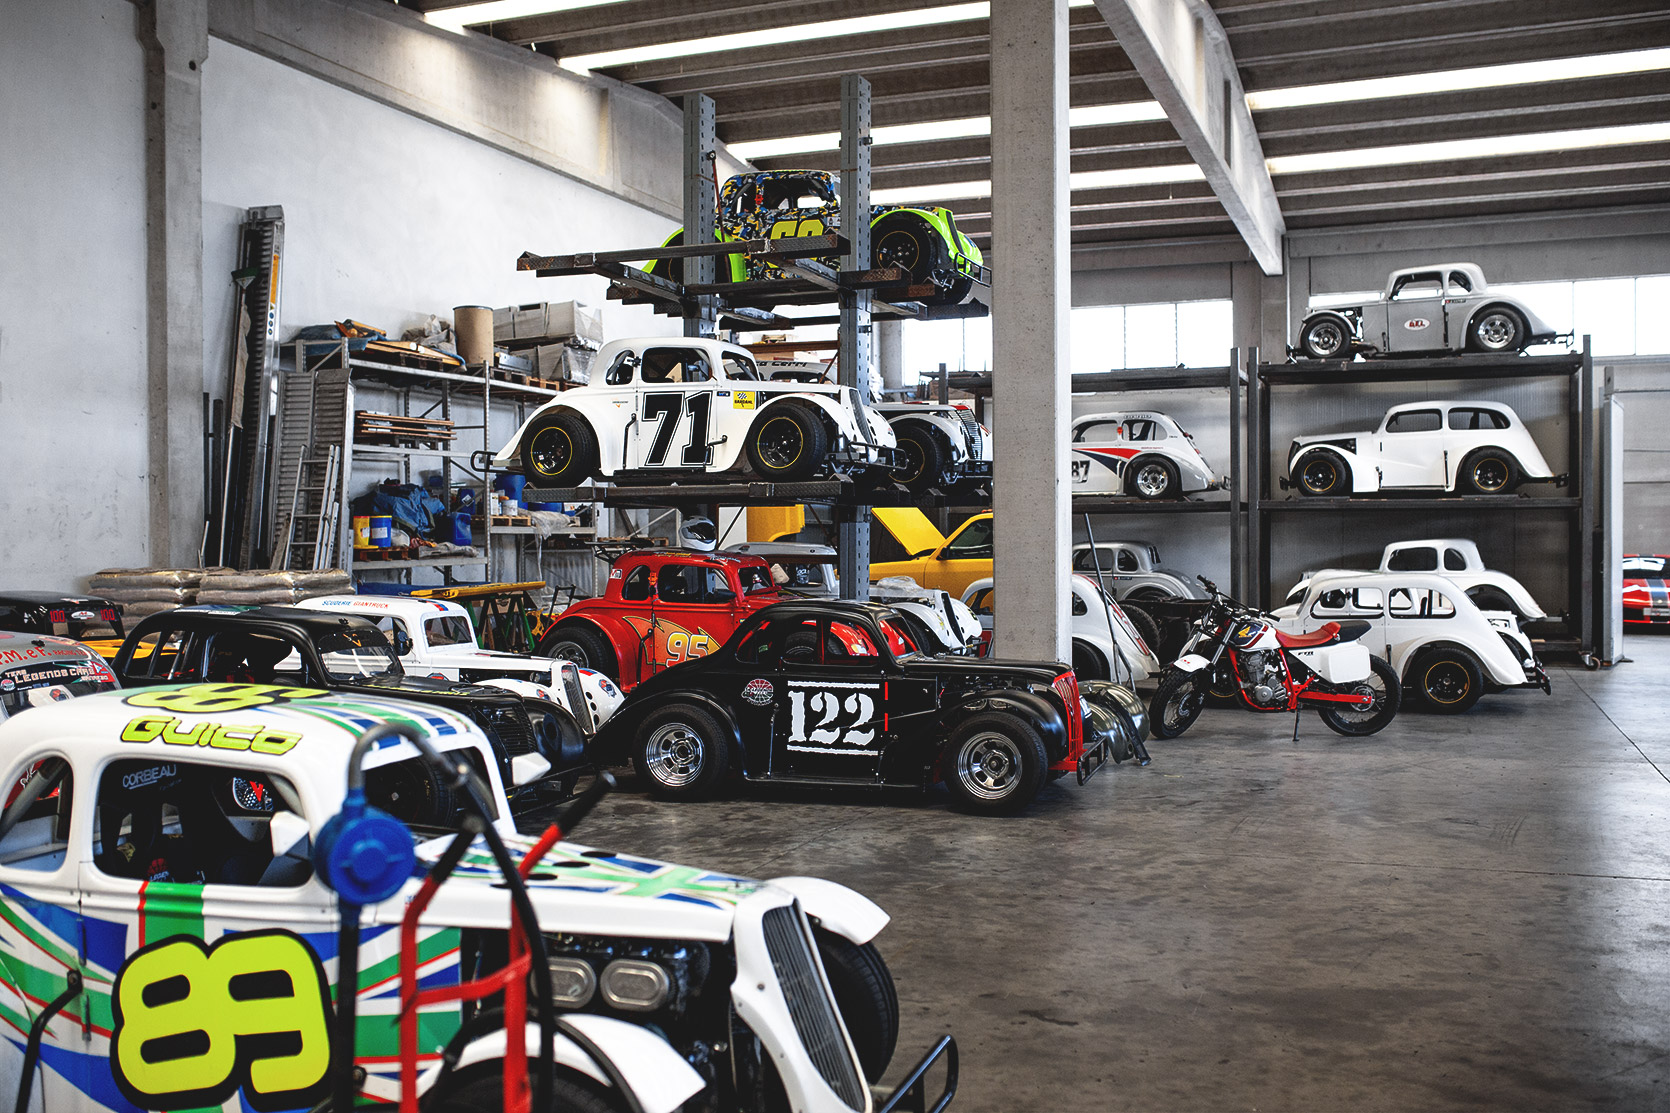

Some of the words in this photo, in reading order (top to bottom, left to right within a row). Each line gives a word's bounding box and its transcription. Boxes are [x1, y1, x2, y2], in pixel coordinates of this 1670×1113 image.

[641, 390, 714, 467] 71
[49, 609, 66, 623] 100
[100, 608, 116, 621] 100
[665, 631, 710, 667] 95
[15, 669, 69, 684] LEGENDS
[787, 690, 876, 746] 122
[122, 763, 178, 789] CORBEAU
[114, 931, 333, 1104] 89
